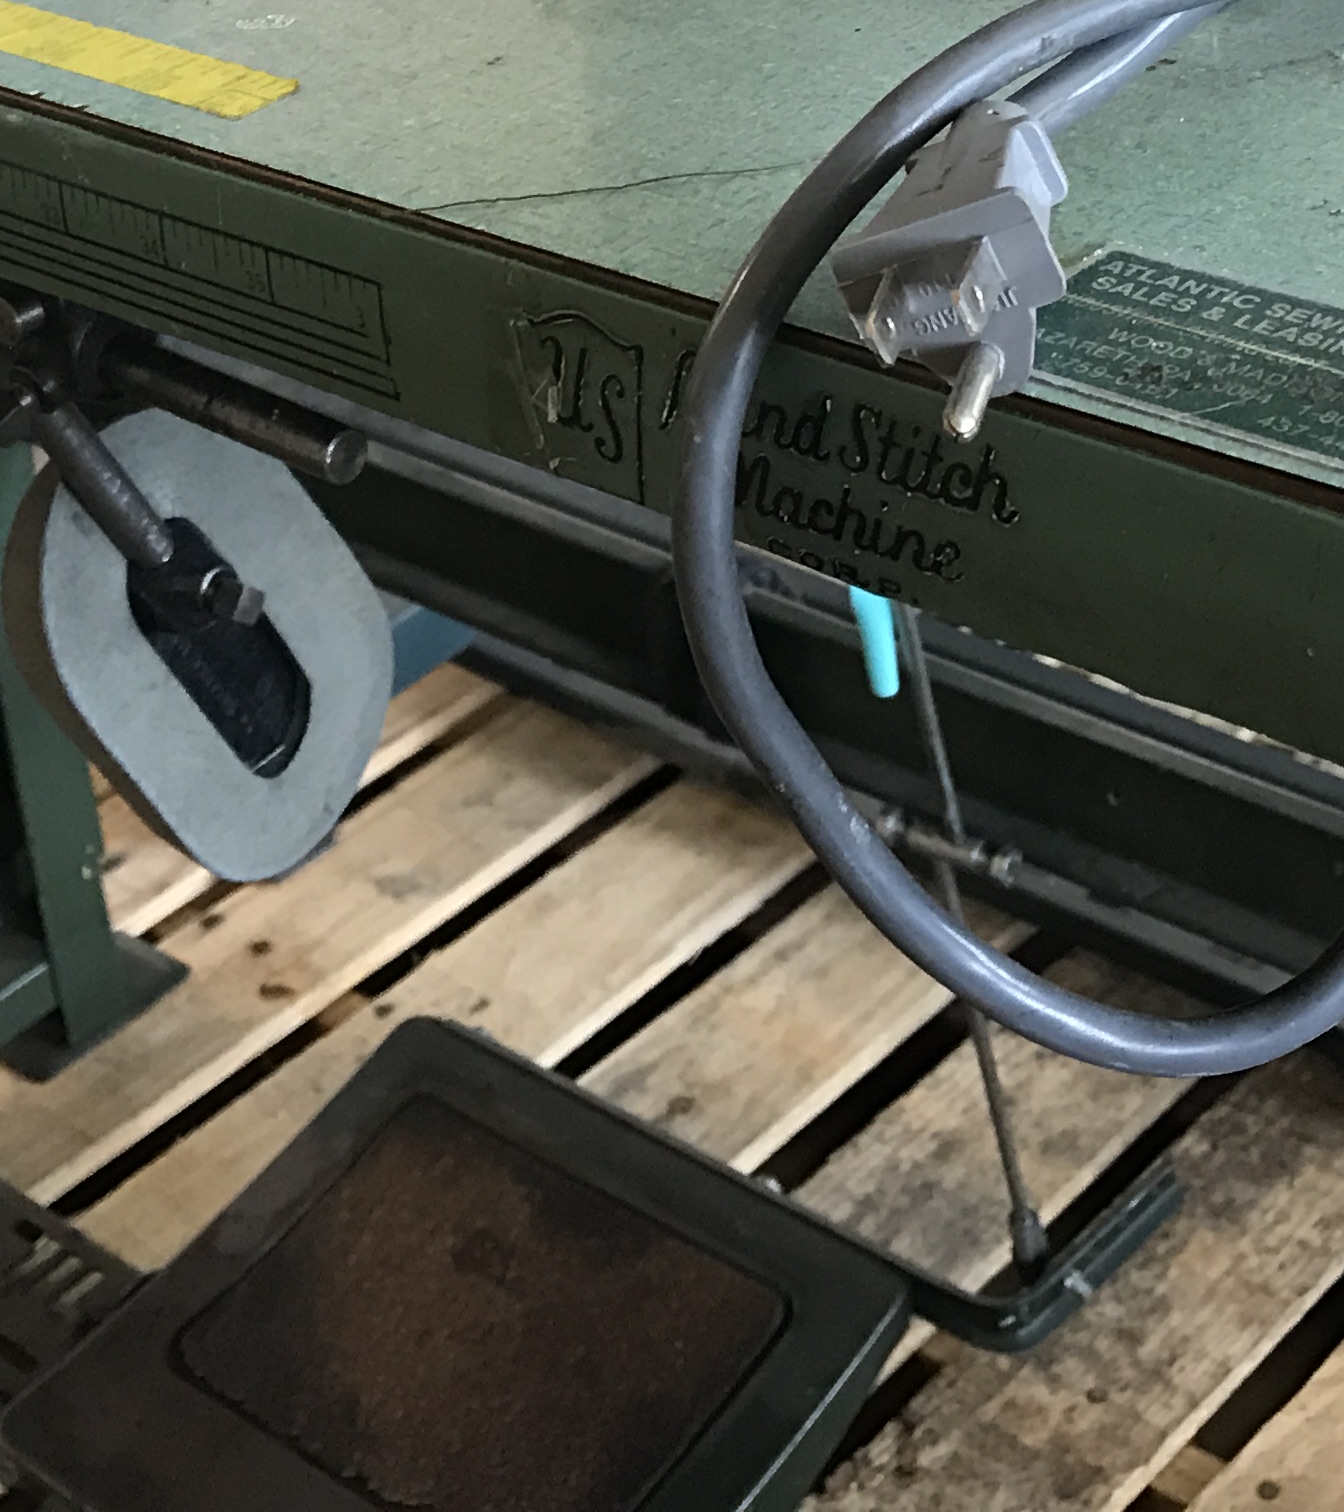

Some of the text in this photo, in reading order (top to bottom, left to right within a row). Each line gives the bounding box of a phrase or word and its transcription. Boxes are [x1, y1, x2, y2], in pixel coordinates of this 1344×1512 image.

[1086, 275, 1201, 313] SALES
[1198, 305, 1232, 321] &
[1095, 258, 1266, 310] ATLANTIC
[1102, 327, 1197, 360] WOOD
[837, 403, 1019, 525] Stitch
